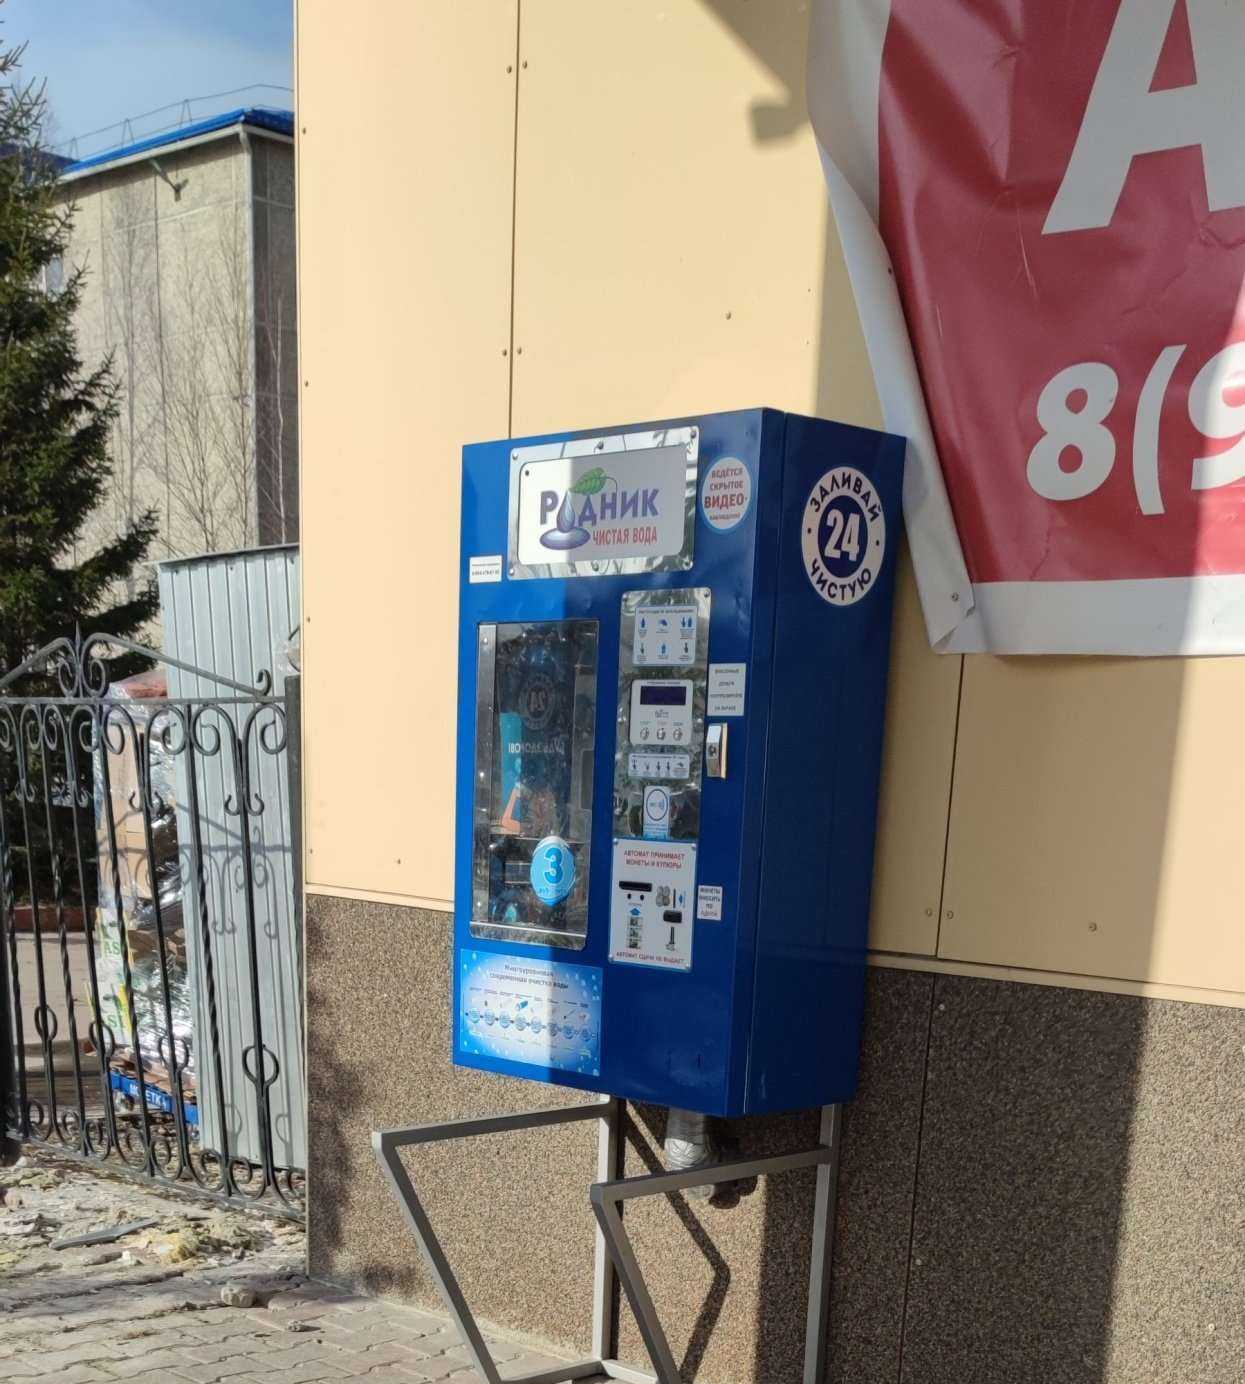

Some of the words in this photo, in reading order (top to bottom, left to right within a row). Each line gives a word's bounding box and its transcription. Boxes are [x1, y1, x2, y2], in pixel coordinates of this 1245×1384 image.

[710, 480, 744, 491] СКРЫТОЕ
[810, 471, 881, 522] ЗАЛИВАЙ
[592, 528, 629, 546] ЧИСТАЯ
[633, 526, 658, 545] ВОДА
[824, 508, 860, 562] 24
[811, 558, 872, 601] ЧИСТУЮ
[544, 847, 564, 885] 3
[624, 849, 650, 857] АВТОМАТ
[651, 851, 685, 860] ПРИНИМАЕТ
[656, 861, 682, 869] КУПЮРЫ
